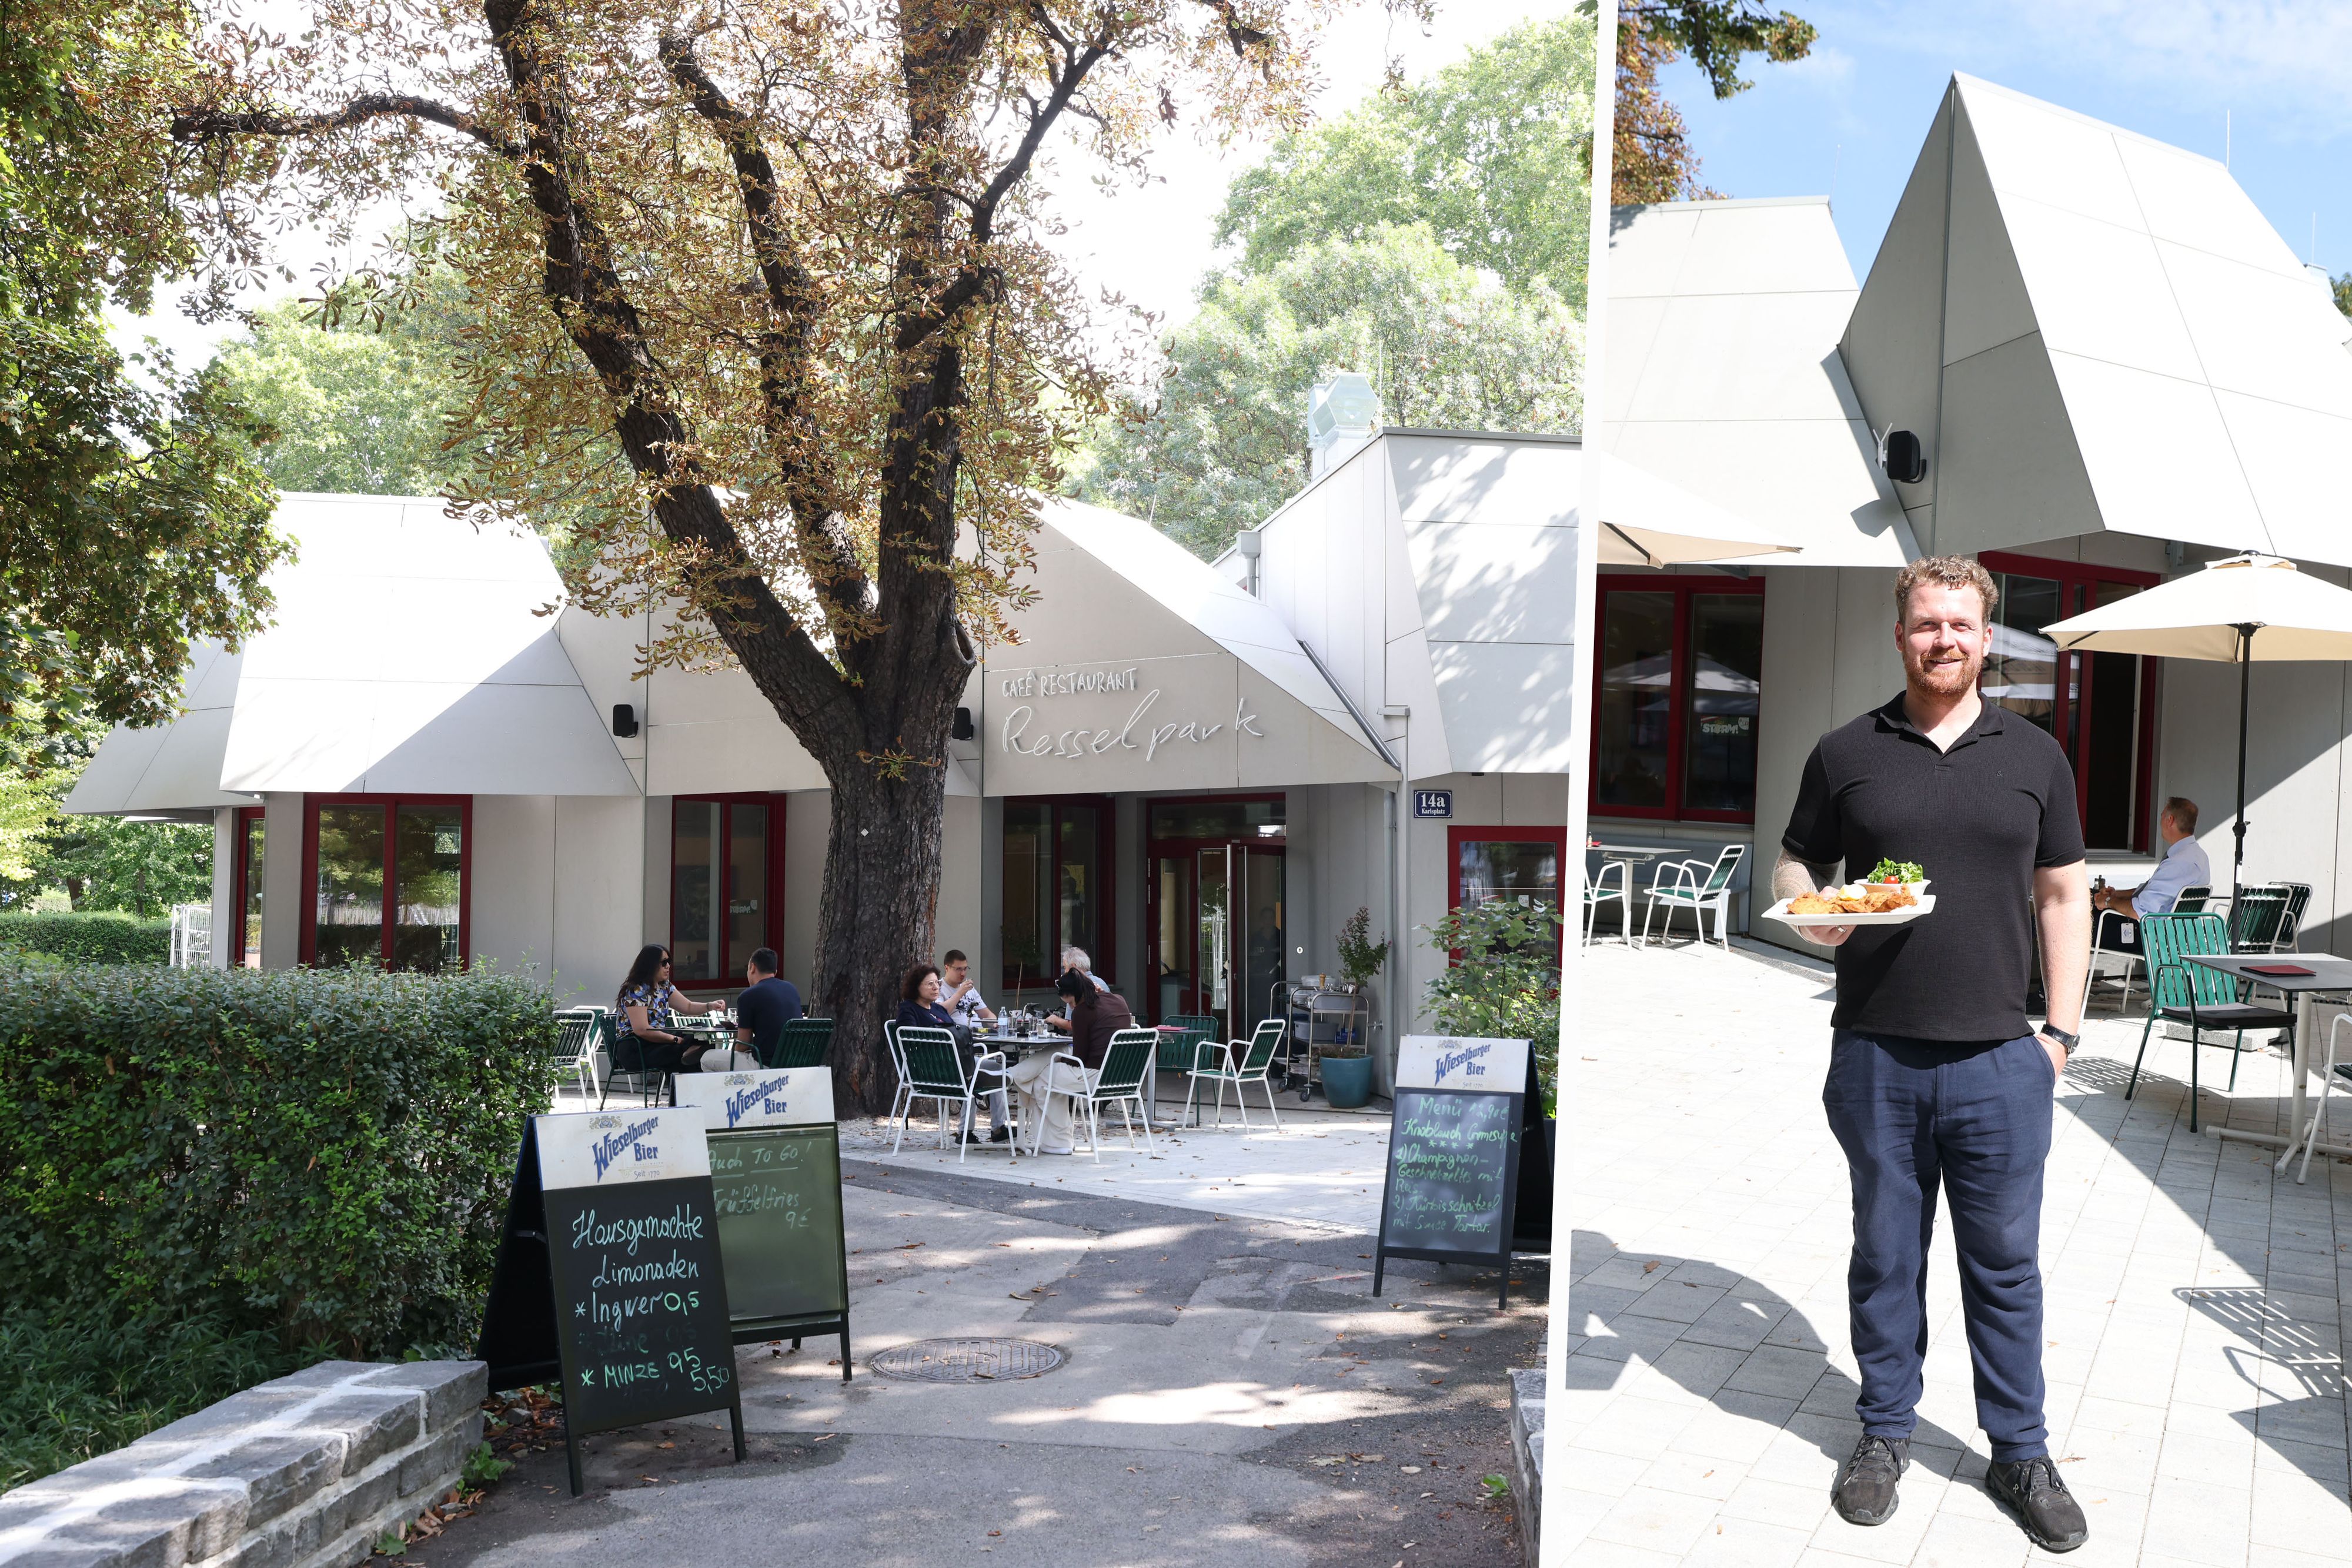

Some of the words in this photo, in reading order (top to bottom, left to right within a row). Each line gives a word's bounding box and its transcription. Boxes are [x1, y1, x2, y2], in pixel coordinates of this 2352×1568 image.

[1040, 667, 1138, 697] RESTAURANT
[1002, 689, 1264, 762] Resselpark
[1421, 793, 1446, 807] 14a
[1434, 1044, 1491, 1087] Wieselburger
[1466, 1061, 1485, 1075] Bier
[725, 1075, 789, 1128] Wieselburger
[764, 1098, 787, 1115] Bier
[1418, 1096, 1463, 1116] Menü
[592, 1116, 659, 1183] Wieselburger
[633, 1142, 659, 1161] Bier
[634, 1171, 646, 1180] Seit
[648, 1170, 660, 1179] 1770
[1477, 1166, 1503, 1182] mit
[572, 1203, 704, 1256] Hausgemachte
[1392, 1213, 1411, 1229] mit
[592, 1248, 699, 1288] Limonaden
[592, 1291, 663, 1332] Ingwer
[664, 1290, 700, 1316] 0,5
[604, 1362, 660, 1389] MINZE
[690, 1365, 730, 1395] 5,50
